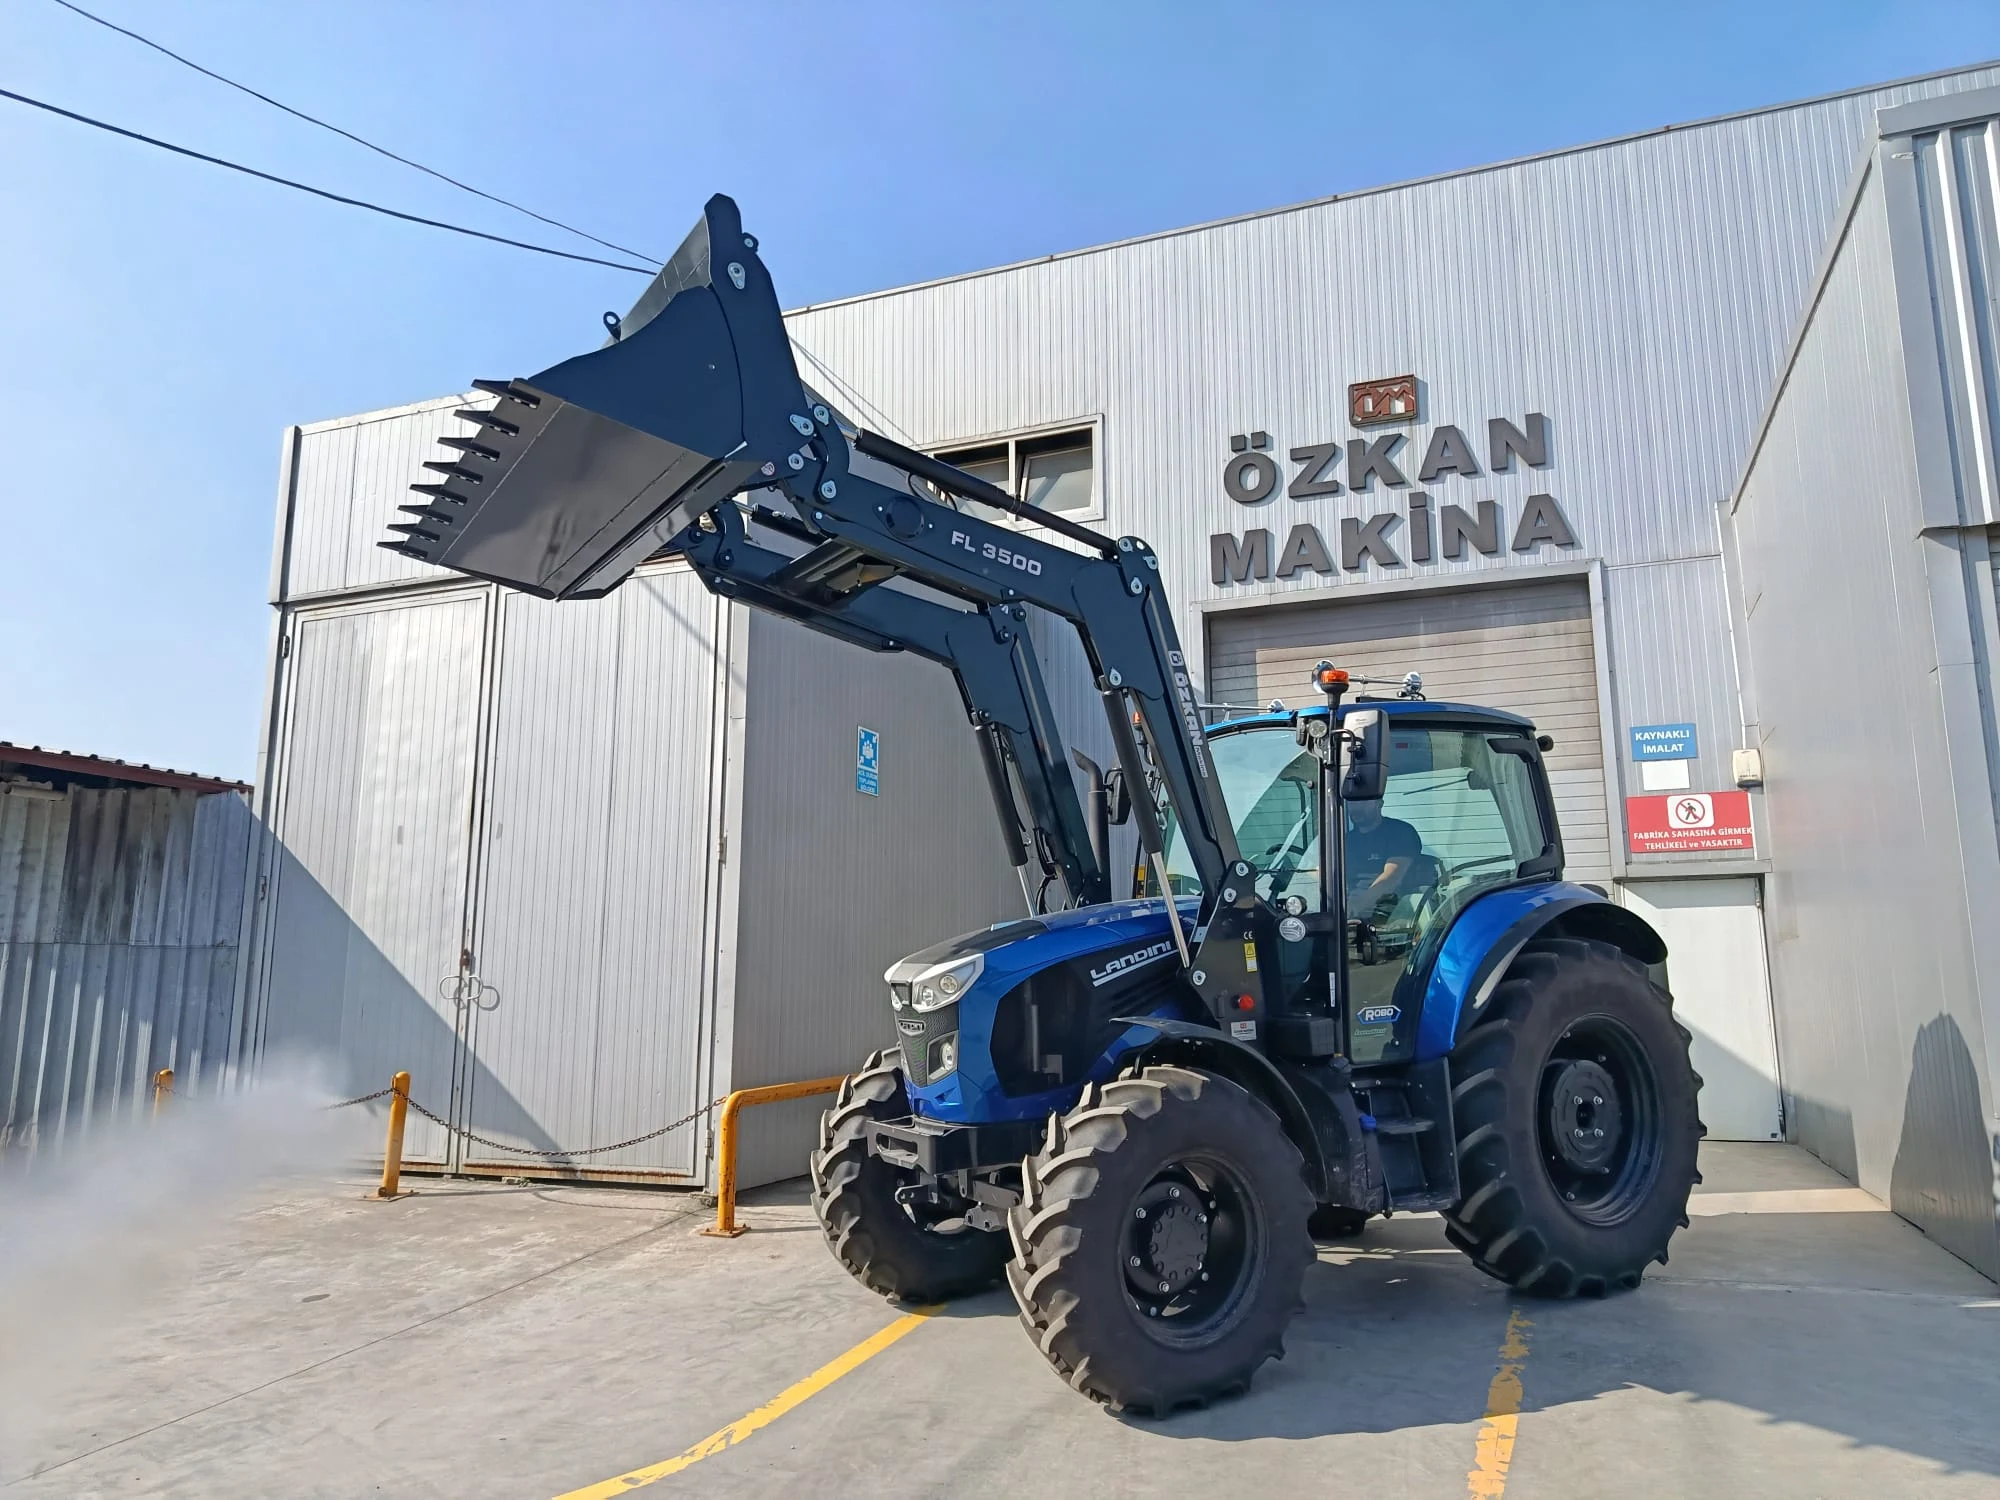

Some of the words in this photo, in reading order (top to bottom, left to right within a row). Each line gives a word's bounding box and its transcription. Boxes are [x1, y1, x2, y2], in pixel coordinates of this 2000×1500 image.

[1223, 412, 1546, 503] ÖZKAN
[1210, 490, 1575, 585] MAKİNA
[951, 530, 976, 553] FL
[982, 543, 1042, 576] 3500
[1635, 729, 1690, 741] KAYNAKLI
[1643, 743, 1684, 754] İMALAT
[1633, 830, 1670, 840] FABRİKA
[1671, 828, 1717, 838] SAHASINA
[1645, 839, 1687, 850] TEHLİKELİ
[1700, 838, 1743, 848] YASAKTIR
[1090, 941, 1172, 979] LANDINI
